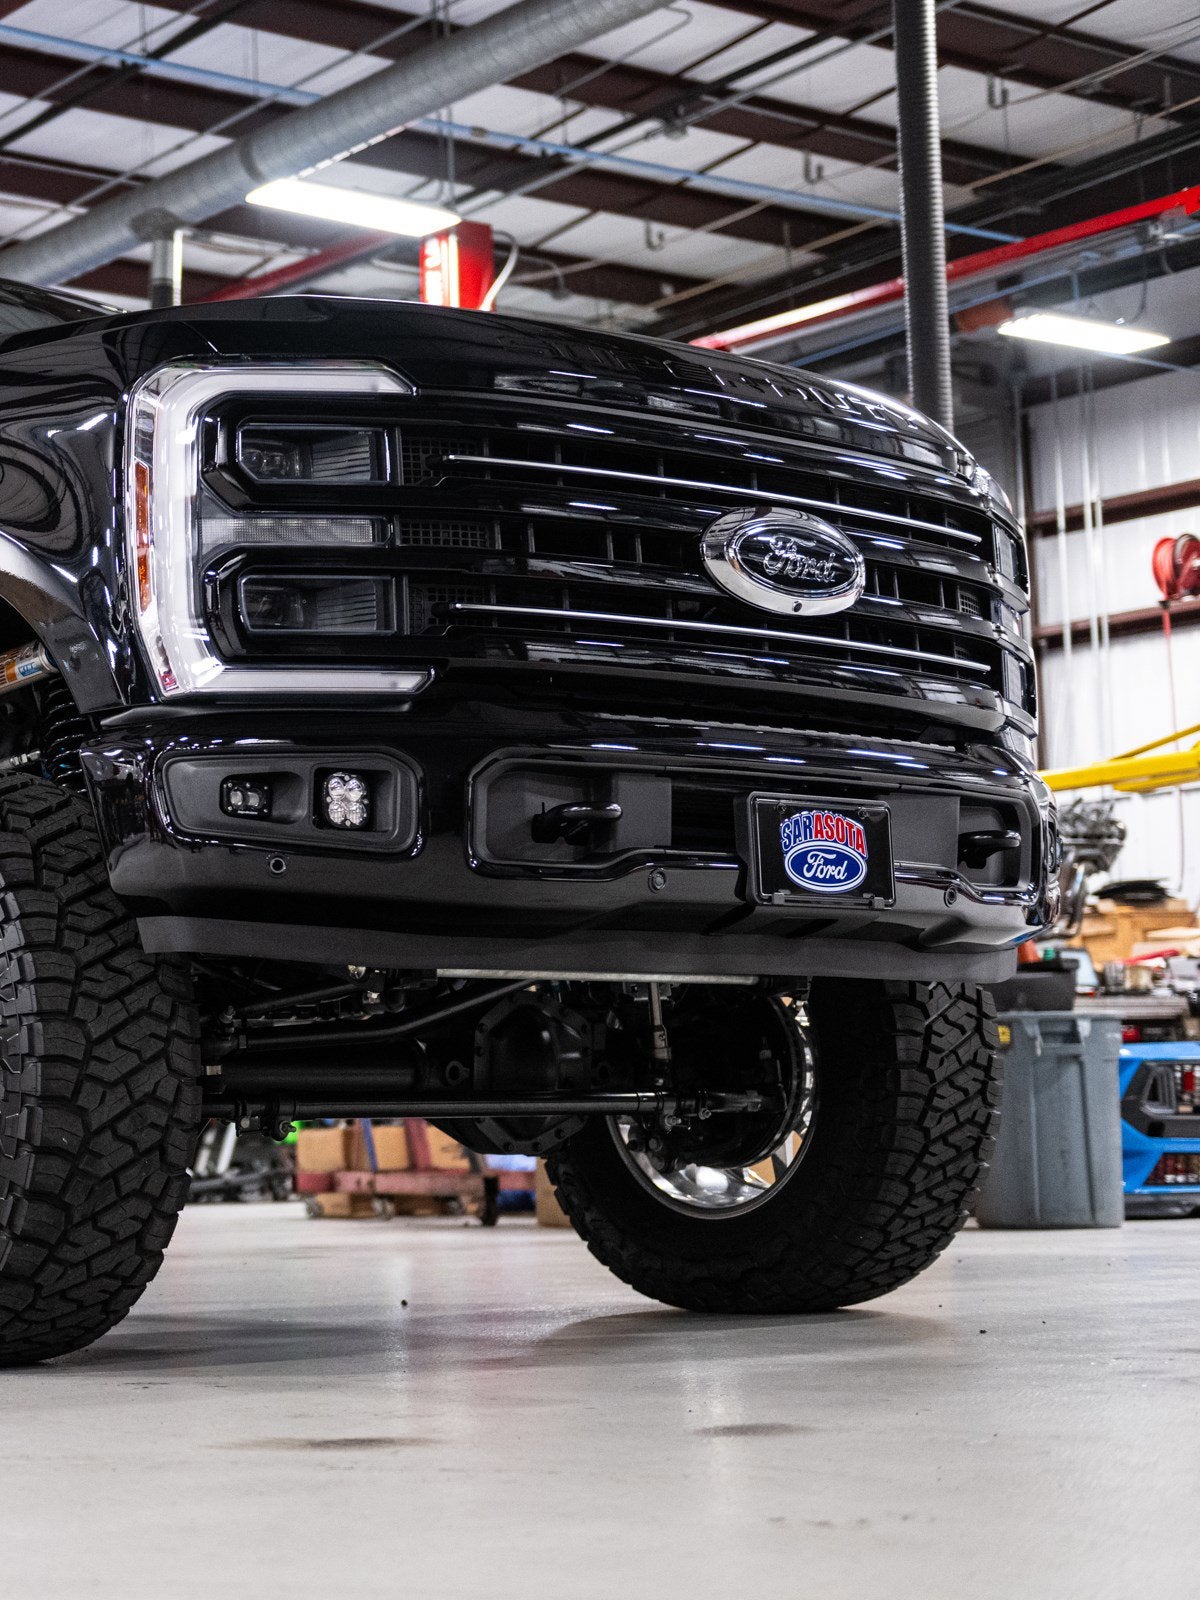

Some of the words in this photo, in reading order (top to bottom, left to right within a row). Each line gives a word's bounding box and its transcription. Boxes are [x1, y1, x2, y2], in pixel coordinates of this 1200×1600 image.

[763, 533, 837, 583] Ford
[781, 812, 867, 859] SARASOTA
[803, 851, 848, 880] Ford
